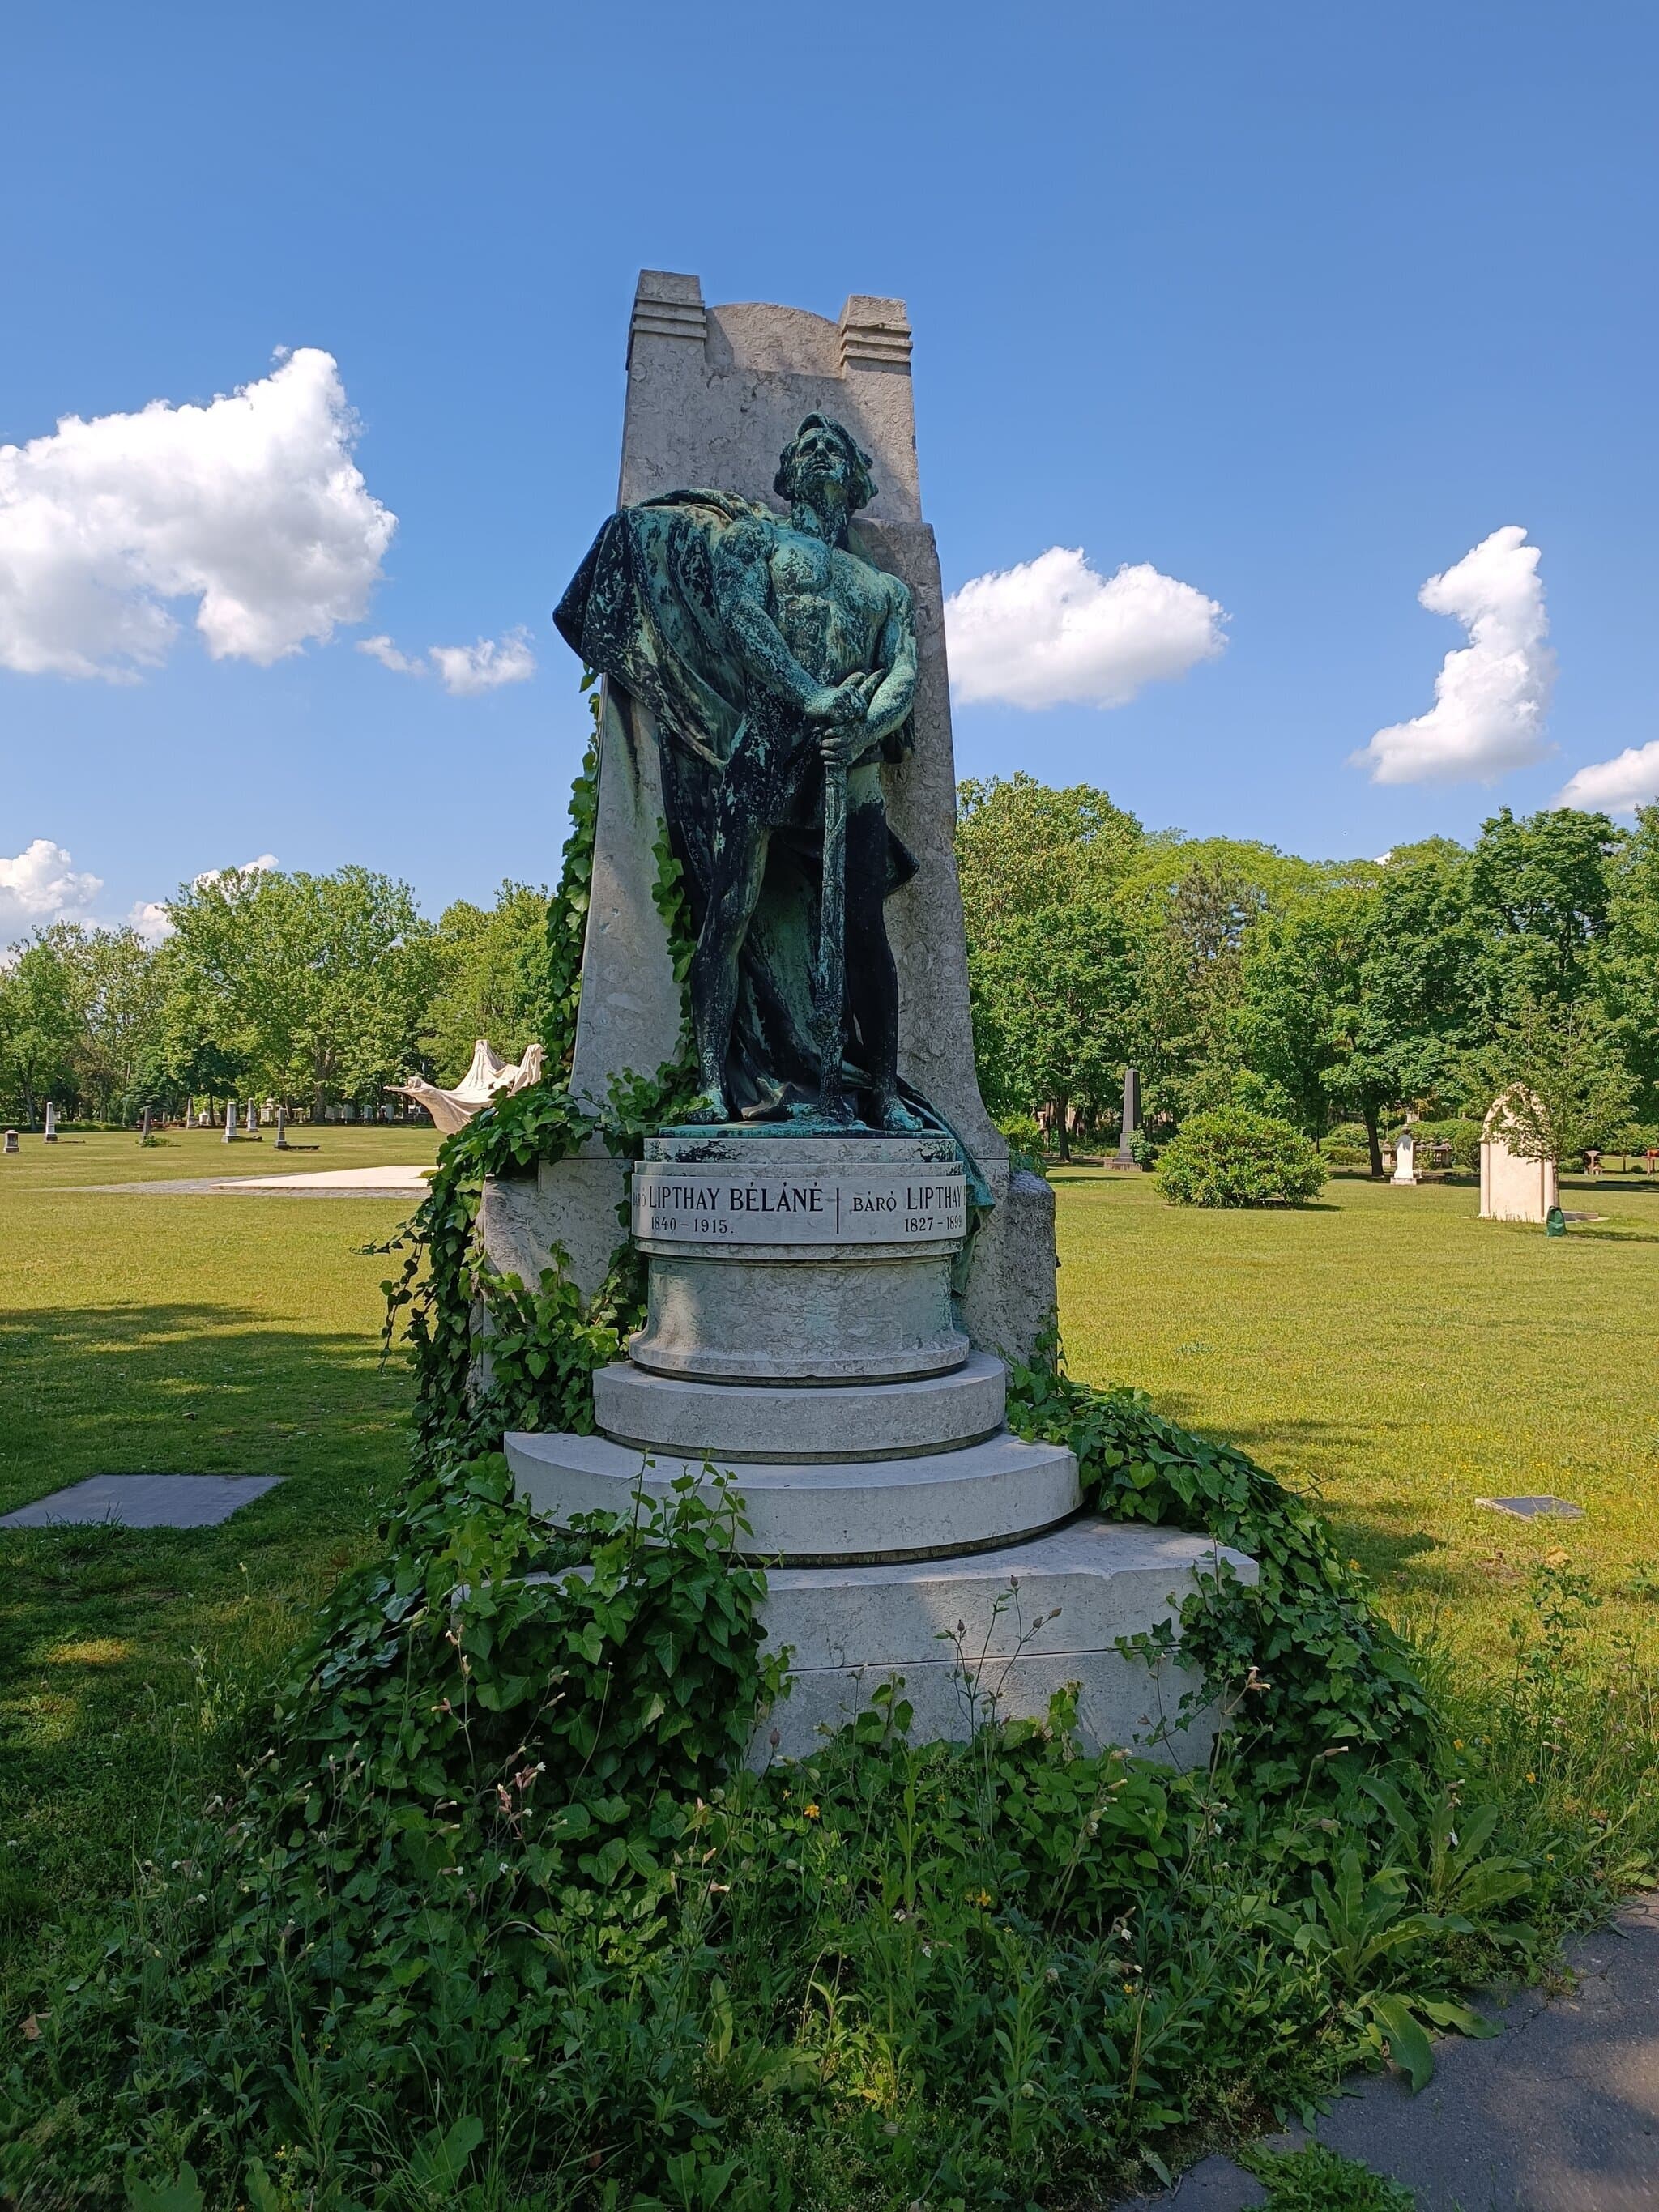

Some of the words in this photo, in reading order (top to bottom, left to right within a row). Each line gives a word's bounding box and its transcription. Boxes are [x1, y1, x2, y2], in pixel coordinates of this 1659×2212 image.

[649, 1185, 720, 1210] LIPTHAY
[730, 1181, 824, 1212] BÉLÁNÉ
[853, 1191, 897, 1212] BÁRÓ
[906, 1185, 962, 1210] LIPTHAY
[651, 1216, 676, 1230] 1840
[694, 1218, 734, 1234] 1915.
[904, 1217, 933, 1232] 1827
